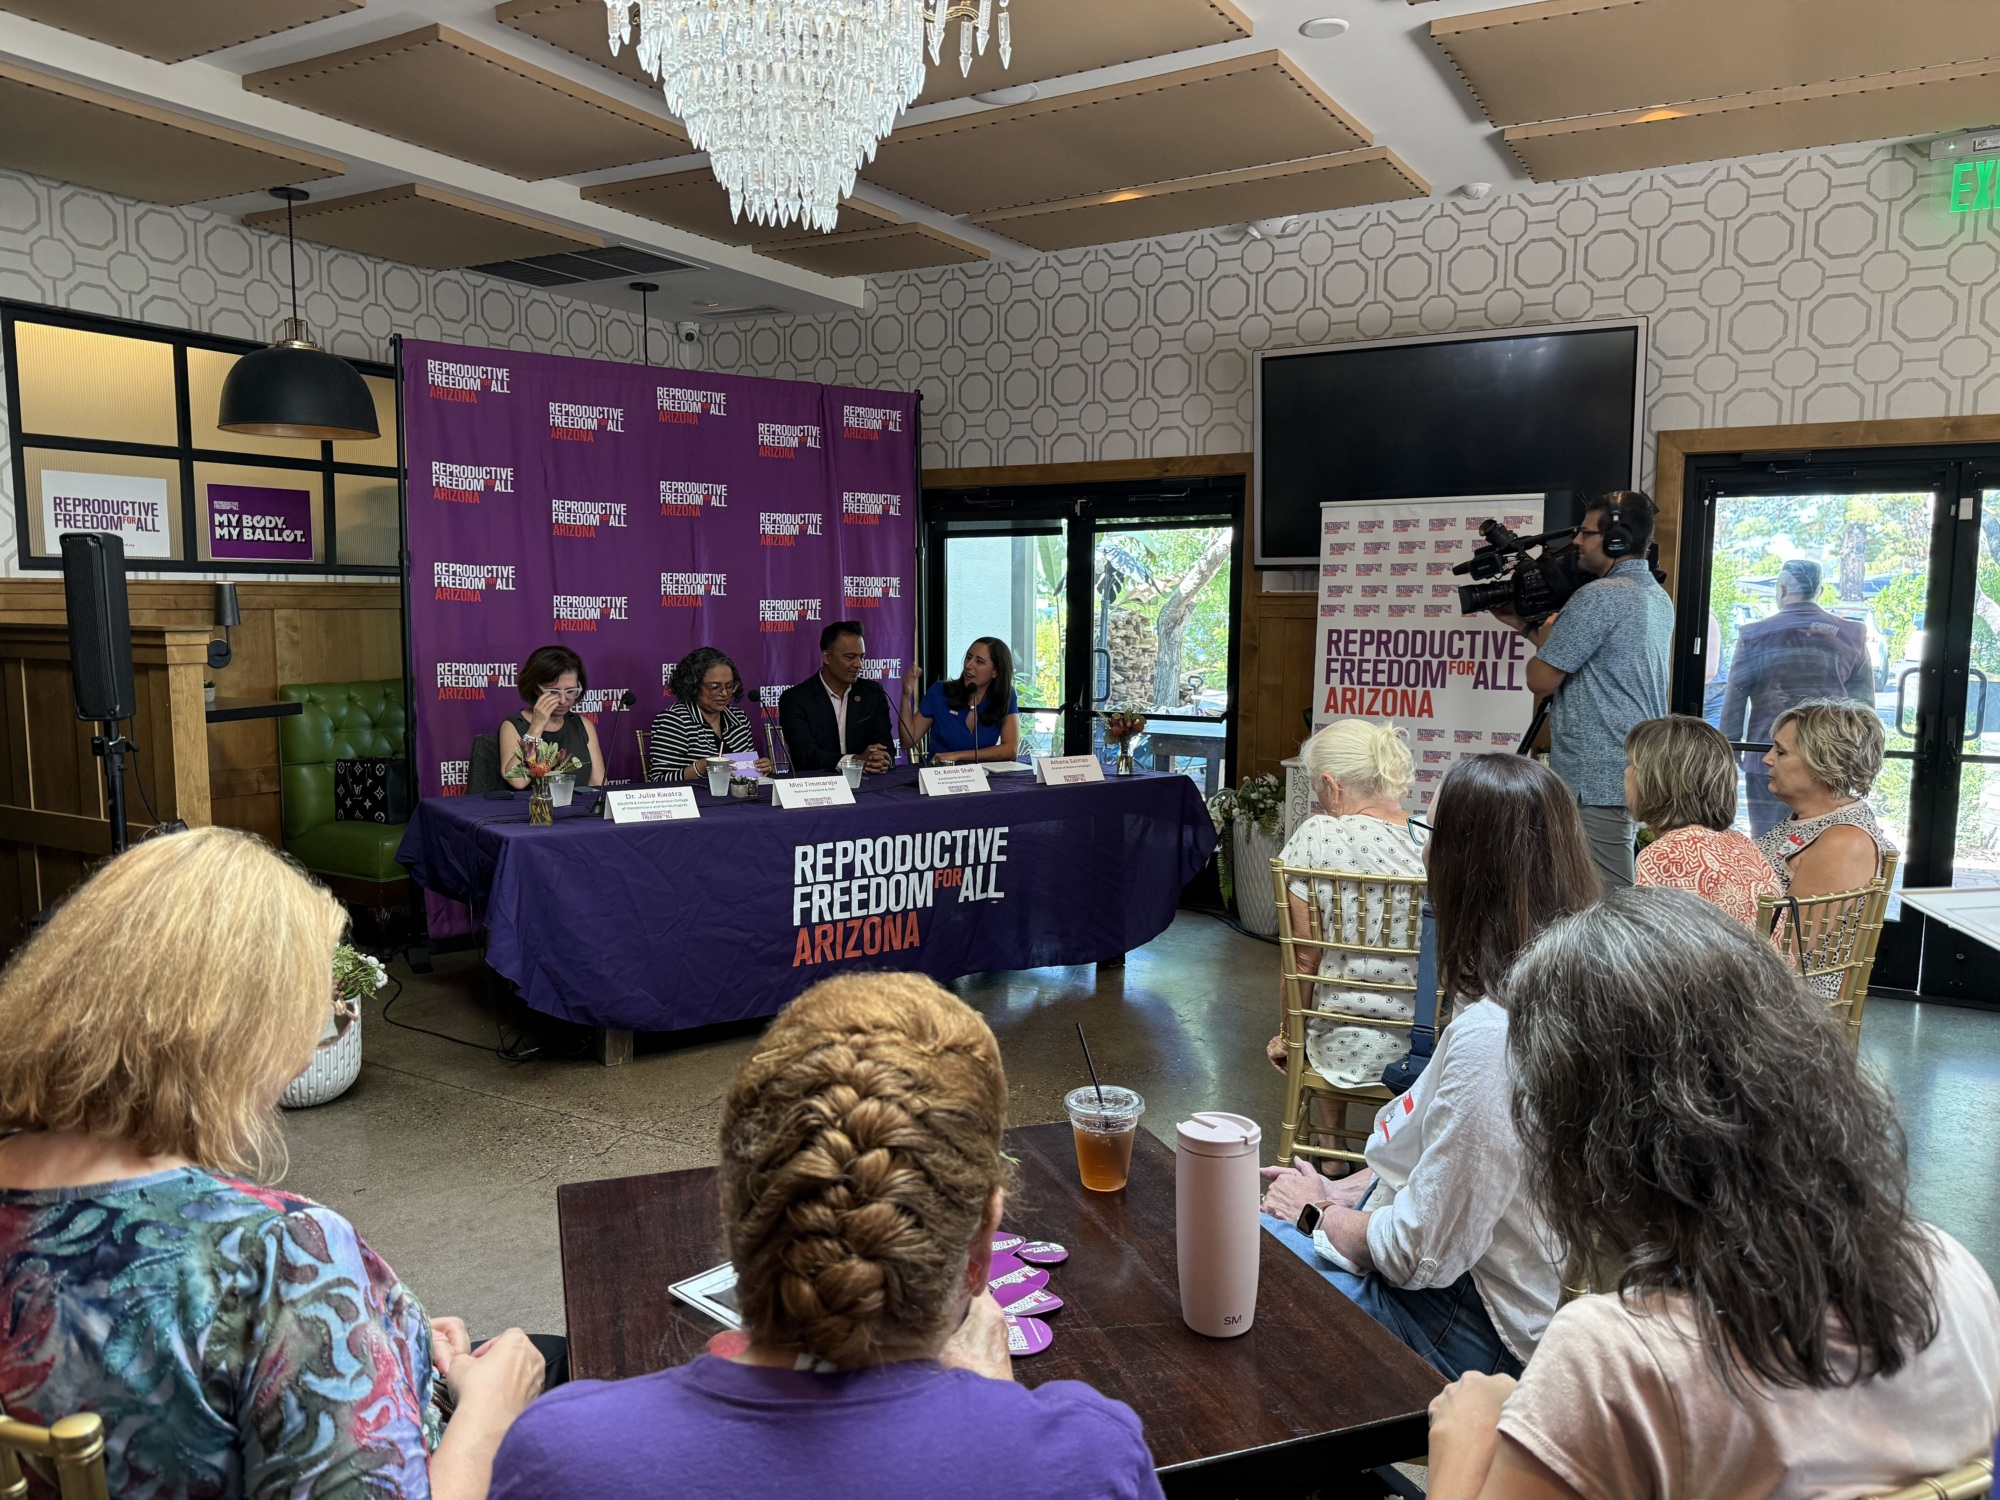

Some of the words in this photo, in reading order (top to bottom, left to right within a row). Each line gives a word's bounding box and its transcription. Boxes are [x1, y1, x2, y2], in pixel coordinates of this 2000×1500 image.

[1950, 160, 2000, 214] EXI
[428, 359, 510, 381] REPRODUCTIVE
[428, 372, 480, 391] FREEDOM
[491, 379, 510, 393] ALL
[430, 386, 477, 403] ARIZONA
[657, 386, 726, 404] REPRODUCTIVE
[549, 402, 624, 420] REPRODUCTIVE
[657, 399, 701, 414] FREEDOM
[710, 404, 727, 416] ALL
[844, 405, 901, 421] REPRODUCTIVE
[550, 415, 597, 430] FREEDOM
[607, 420, 624, 432] ALL
[659, 411, 698, 425] ARIZONA
[844, 417, 882, 430] FREEDOM
[889, 421, 902, 432] ALL
[551, 428, 594, 442] ARIZONA
[758, 423, 820, 438] REPRODUCTIVE
[844, 428, 878, 441] ARIZONA
[758, 434, 798, 448] FREEDOM
[807, 437, 821, 448] ALL
[759, 446, 795, 459] ARIZONA
[432, 461, 514, 480] REPRODUCTIVE
[432, 474, 484, 491] FREEDOM
[494, 480, 514, 492] ALL
[660, 481, 727, 496] REPRODUCTIVE
[433, 488, 479, 503] ARIZONA
[660, 492, 703, 505] FREEDOM
[711, 495, 727, 507] ALL
[843, 492, 901, 505] REPRODUCTIVE
[53, 496, 159, 517] REPRODUCTIVE
[552, 499, 627, 515] REPRODUCTIVE
[661, 504, 701, 517] ARIZONA
[843, 503, 882, 515] FREEDOM
[889, 505, 901, 516] ALL
[54, 513, 122, 531] FREEDOM
[123, 516, 136, 524] FOR
[136, 517, 160, 532] ALL
[214, 513, 239, 526] MY
[242, 514, 286, 528] BODY.
[552, 512, 599, 526] FREEDOM
[609, 515, 627, 527] ALL
[760, 512, 822, 524] REPRODUCTIVE
[844, 514, 879, 525] ARIZONA
[215, 527, 240, 539] MY
[243, 528, 305, 542] BALLOT.
[553, 524, 595, 537] ARIZONA
[760, 524, 799, 535] FREEDOM
[807, 525, 822, 535] ALL
[760, 534, 795, 546] ARIZONA
[434, 562, 515, 578] REPRODUCTIVE
[435, 575, 485, 590] FREEDOM
[496, 578, 516, 590] ALL
[661, 573, 727, 585] REPRODUCTIVE
[844, 576, 900, 587] REPRODUCTIVE
[435, 588, 481, 602] ARIZONA
[661, 584, 704, 595] FREEDOM
[711, 585, 727, 596] ALL
[844, 587, 882, 597] FREEDOM
[888, 587, 900, 598] ALL
[553, 595, 628, 608] REPRODUCTIVE
[662, 596, 702, 607] ARIZONA
[760, 599, 821, 610] REPRODUCTIVE
[554, 607, 600, 619] FREEDOM
[610, 608, 628, 619] ALL
[760, 610, 798, 621] FREEDOM
[806, 610, 821, 620] ALL
[554, 619, 596, 631] ARIZONA
[760, 622, 794, 632] ARIZONA
[1327, 629, 1524, 660] REPRODUCTIVE
[437, 663, 517, 675] REPRODUCTIVE
[862, 659, 901, 669] ODUCTIVE
[858, 669, 882, 679] EDOM
[889, 669, 901, 678] ALL
[1325, 657, 1447, 689] FREEDOM
[1449, 660, 1475, 676] FOR
[1472, 661, 1522, 691] ALL
[437, 675, 488, 688] FREEDOM
[498, 675, 518, 687] ALL
[438, 688, 485, 700] ARIZONA
[584, 689, 629, 701] ODUCTIV
[570, 701, 602, 713] EEDOM
[760, 697, 779, 707] FREE
[1324, 686, 1434, 718] ARIZONA
[761, 707, 779, 718] ARIZ
[441, 773, 468, 786] FREE
[443, 785, 467, 797] ARIZ
[794, 827, 1008, 885] REPRODUCTIVE
[793, 870, 933, 926] FREEDOM
[934, 868, 962, 889] FOR
[958, 864, 1004, 903] ALL
[792, 911, 920, 967] ARIZONA
